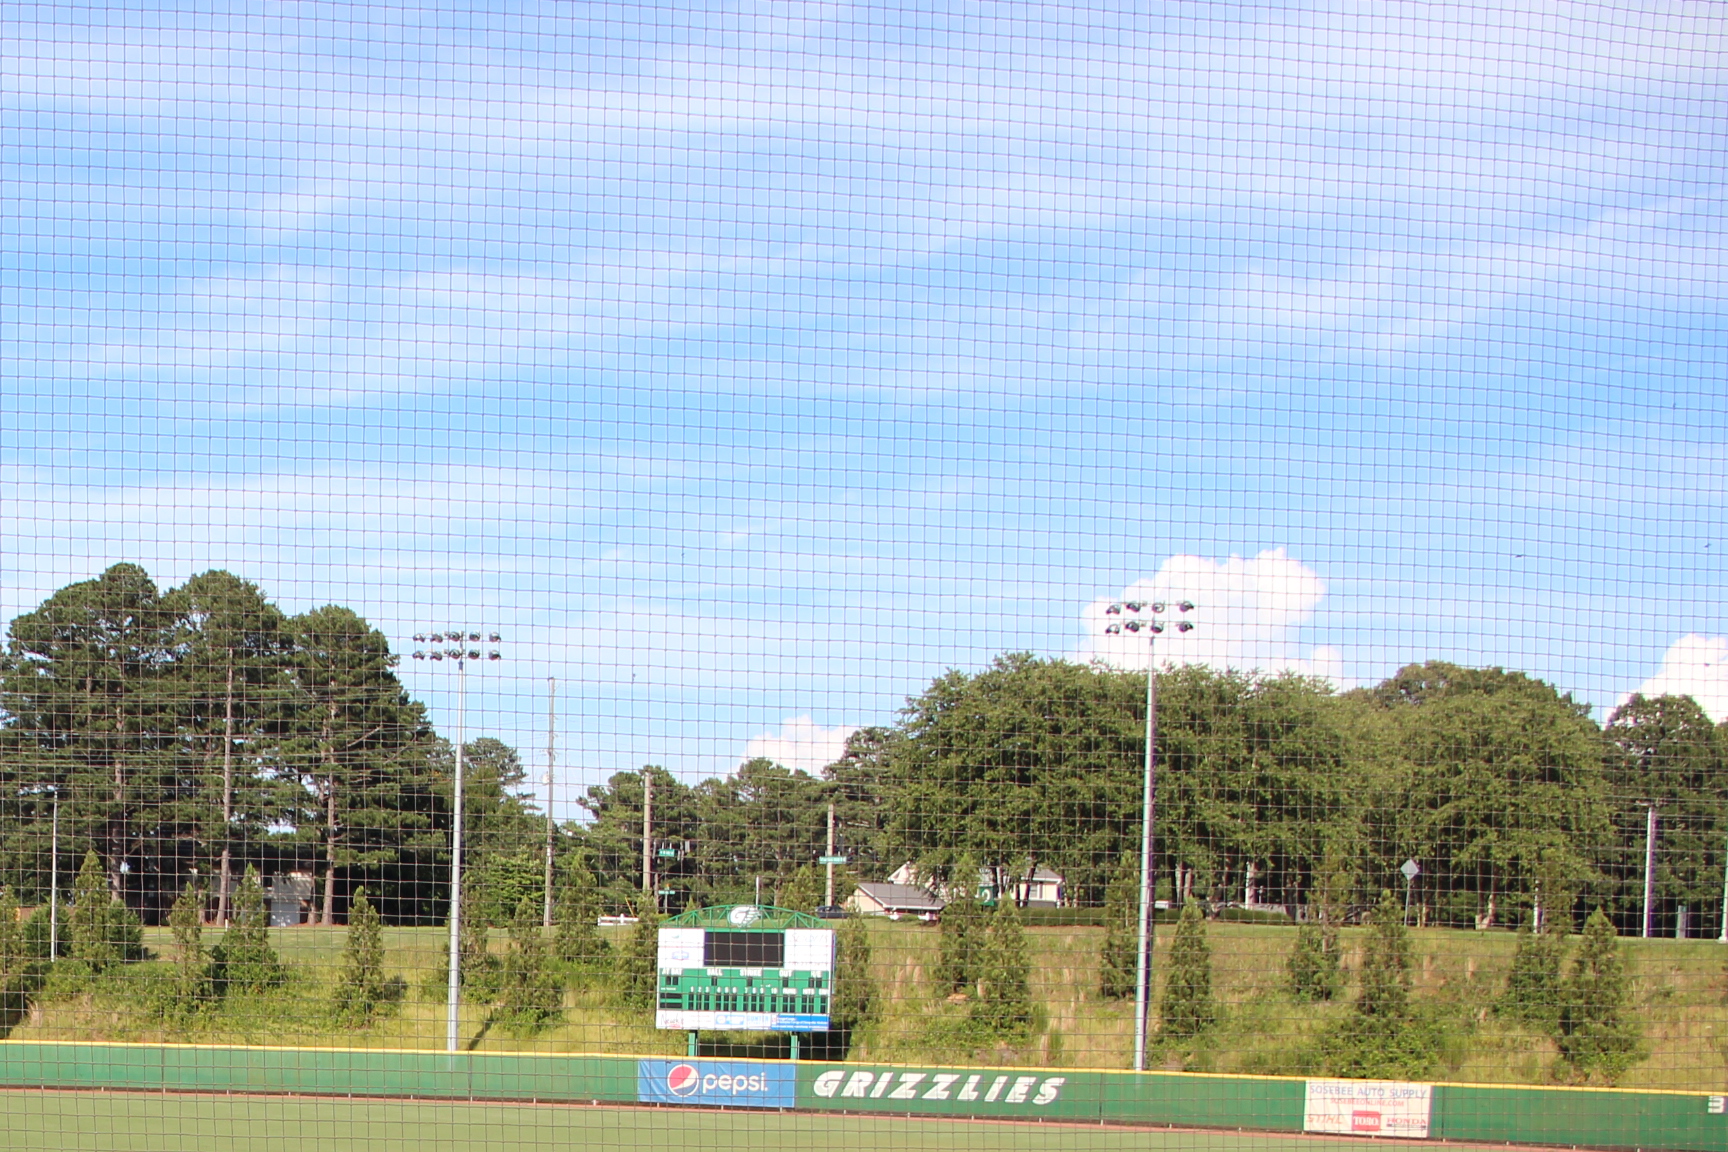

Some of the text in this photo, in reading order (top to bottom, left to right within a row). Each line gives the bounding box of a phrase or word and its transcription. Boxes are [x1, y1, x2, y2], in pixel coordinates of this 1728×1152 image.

[706, 968, 723, 977] BALL
[739, 968, 762, 977] STRIKE
[779, 970, 792, 978] OUT
[813, 1070, 1065, 1105] GRIZZLIES
[1309, 1085, 1427, 1099] SOSEBEE AUTO SUPPLY
[1330, 1098, 1405, 1107] SOSEBEEONLINE.COM
[1306, 1114, 1343, 1125] STIHL
[1387, 1117, 1427, 1125] HONDA
